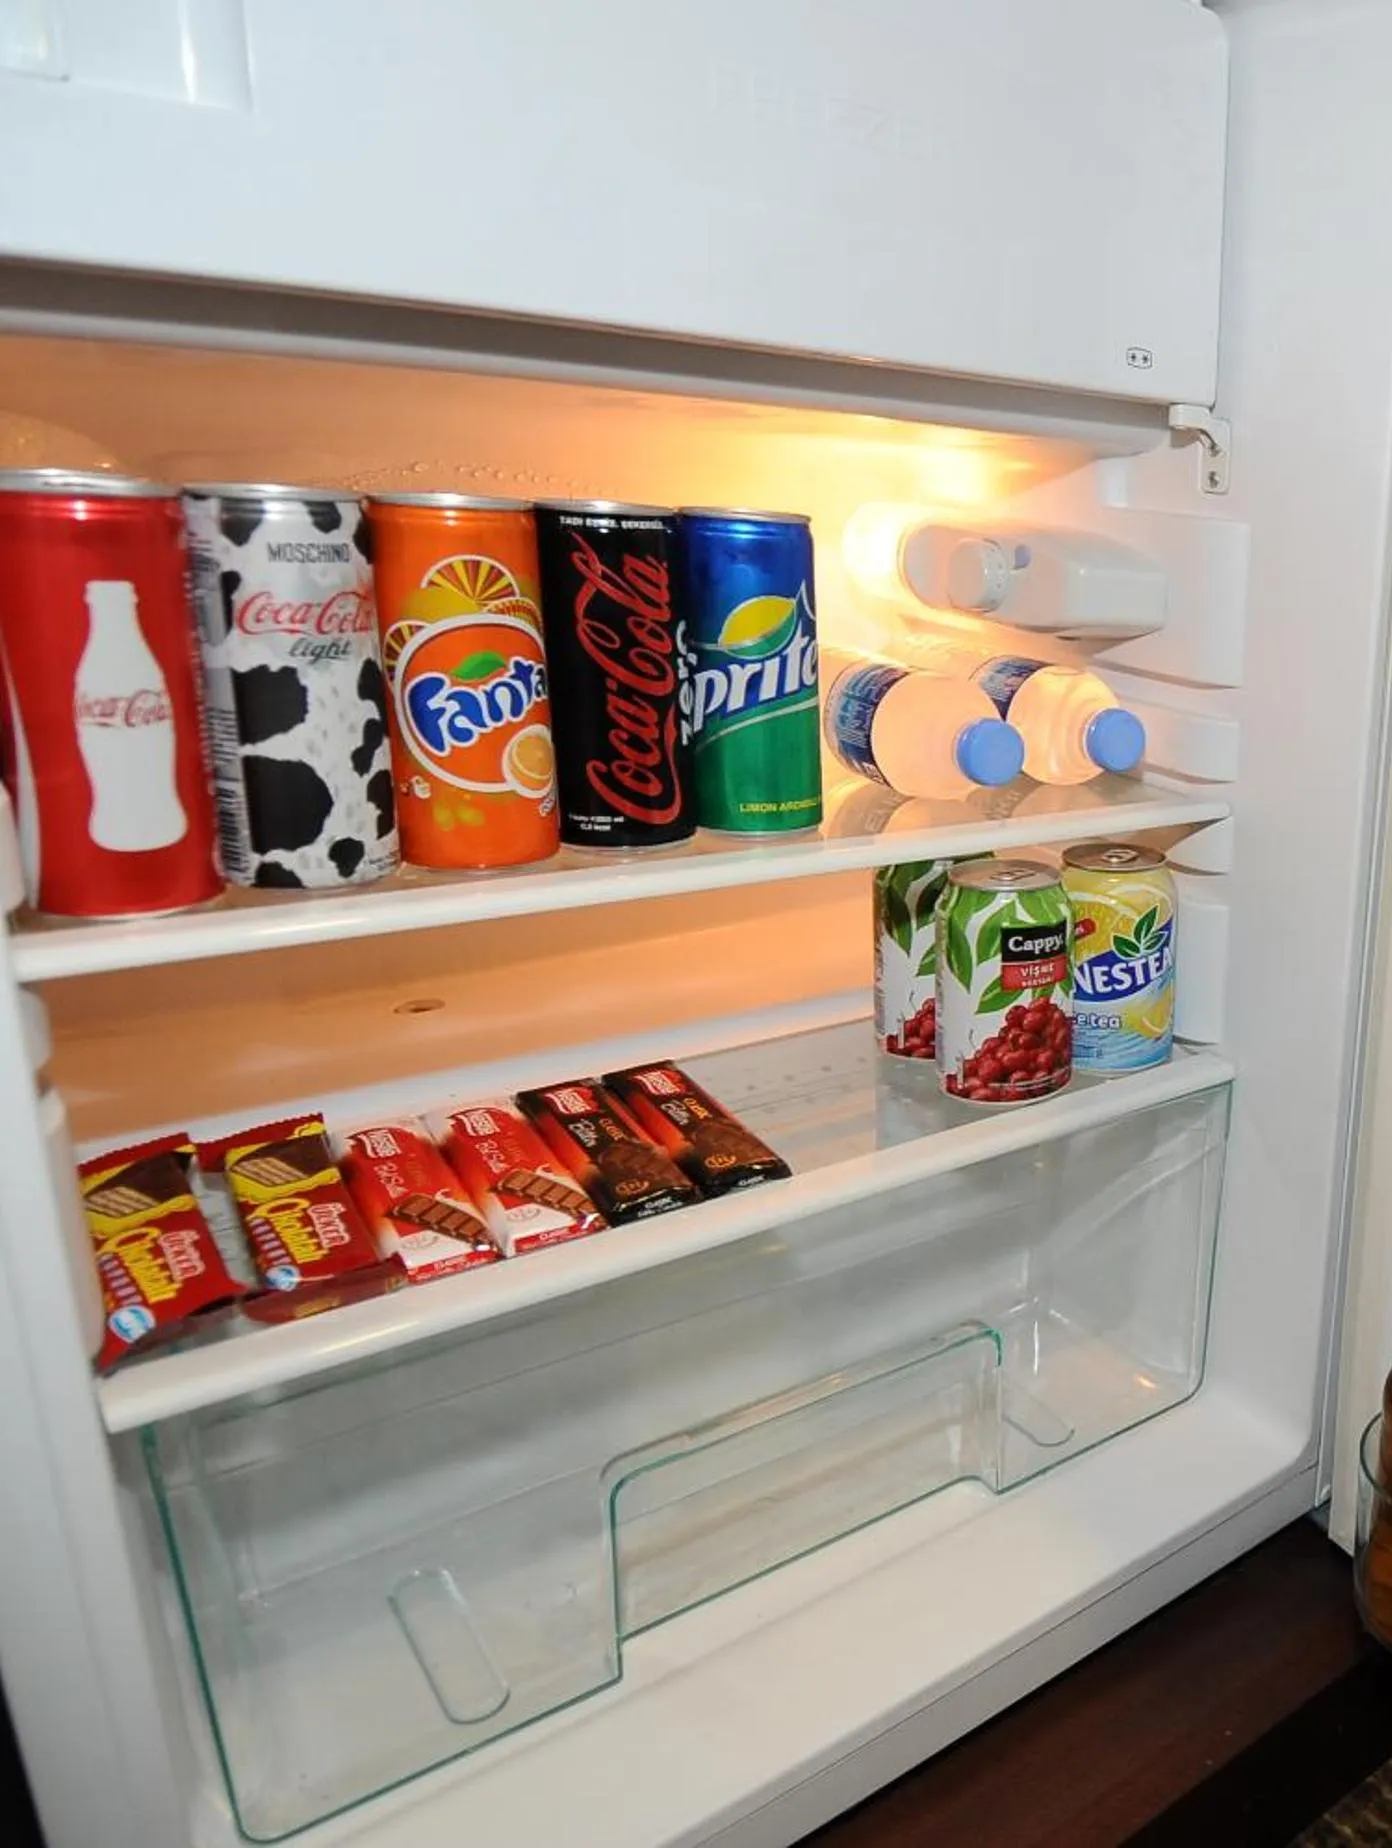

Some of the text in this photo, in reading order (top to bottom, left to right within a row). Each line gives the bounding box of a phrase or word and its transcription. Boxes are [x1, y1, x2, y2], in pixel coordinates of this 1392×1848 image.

[267, 541, 351, 564] MOSCHINO
[289, 637, 351, 665] light
[693, 620, 818, 734] prite
[407, 656, 549, 756] Fanta
[1008, 934, 1064, 955] Cappy
[1074, 947, 1174, 996] NESTEA
[1089, 1013, 1122, 1029] tea
